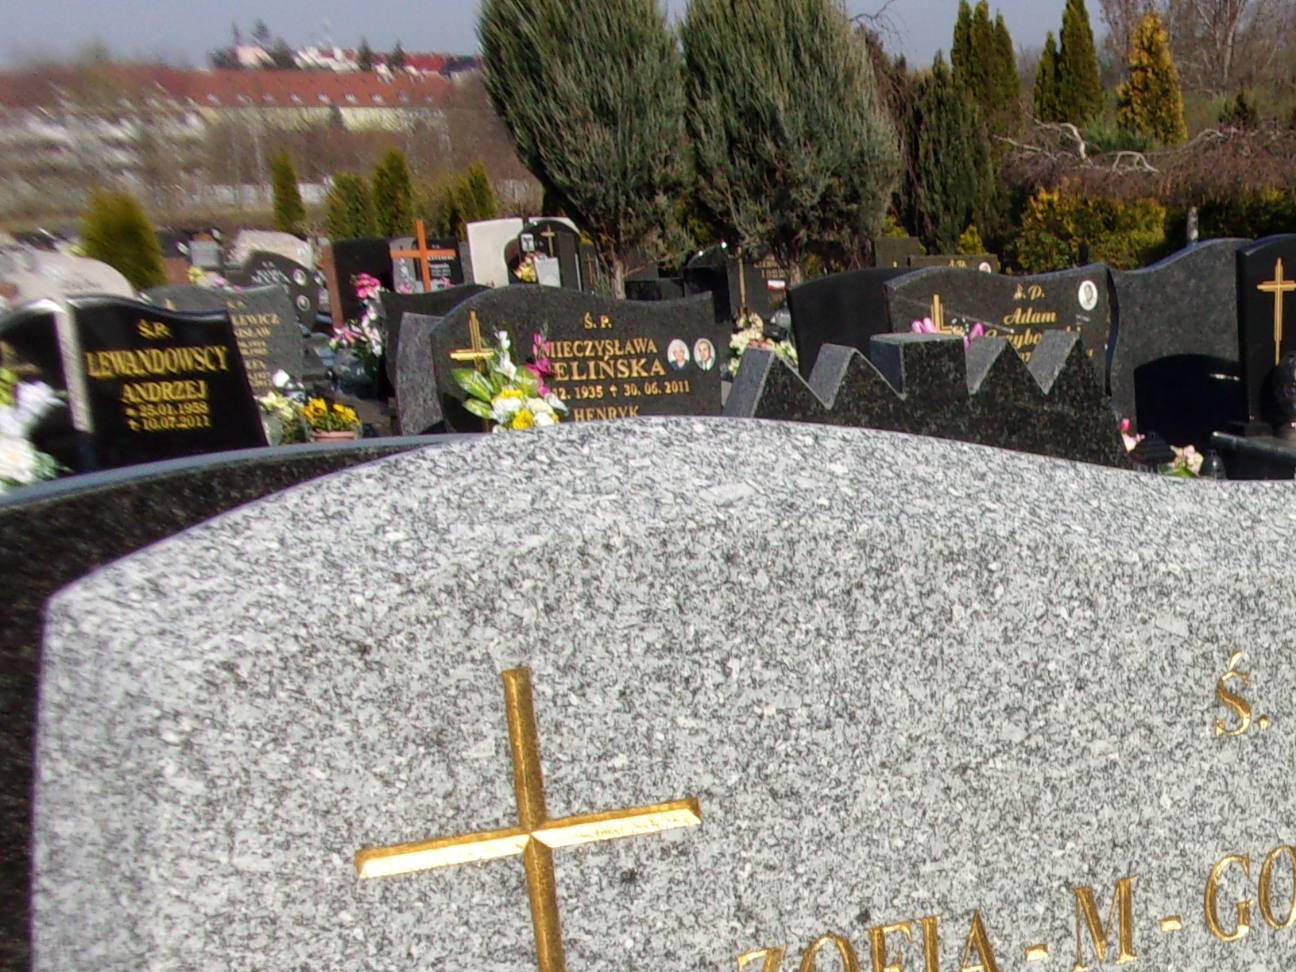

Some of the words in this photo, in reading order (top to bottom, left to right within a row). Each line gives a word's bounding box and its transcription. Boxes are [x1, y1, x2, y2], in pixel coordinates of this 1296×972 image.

[231, 312, 280, 327] LEWICZ
[583, 311, 597, 329] Ś.
[600, 314, 613, 329] P.
[1003, 306, 1058, 326] Adam
[544, 337, 658, 359] MIECZYSŁAWA
[86, 346, 229, 378] LEWANDOWSCY
[555, 354, 666, 381] ELIŃSKA
[120, 379, 209, 404] ANDRZEJ
[575, 384, 604, 400] 1935
[622, 382, 642, 397] 30.
[643, 381, 663, 396] 06.
[664, 379, 691, 395] 2011
[1215, 650, 1270, 737] Ś.
